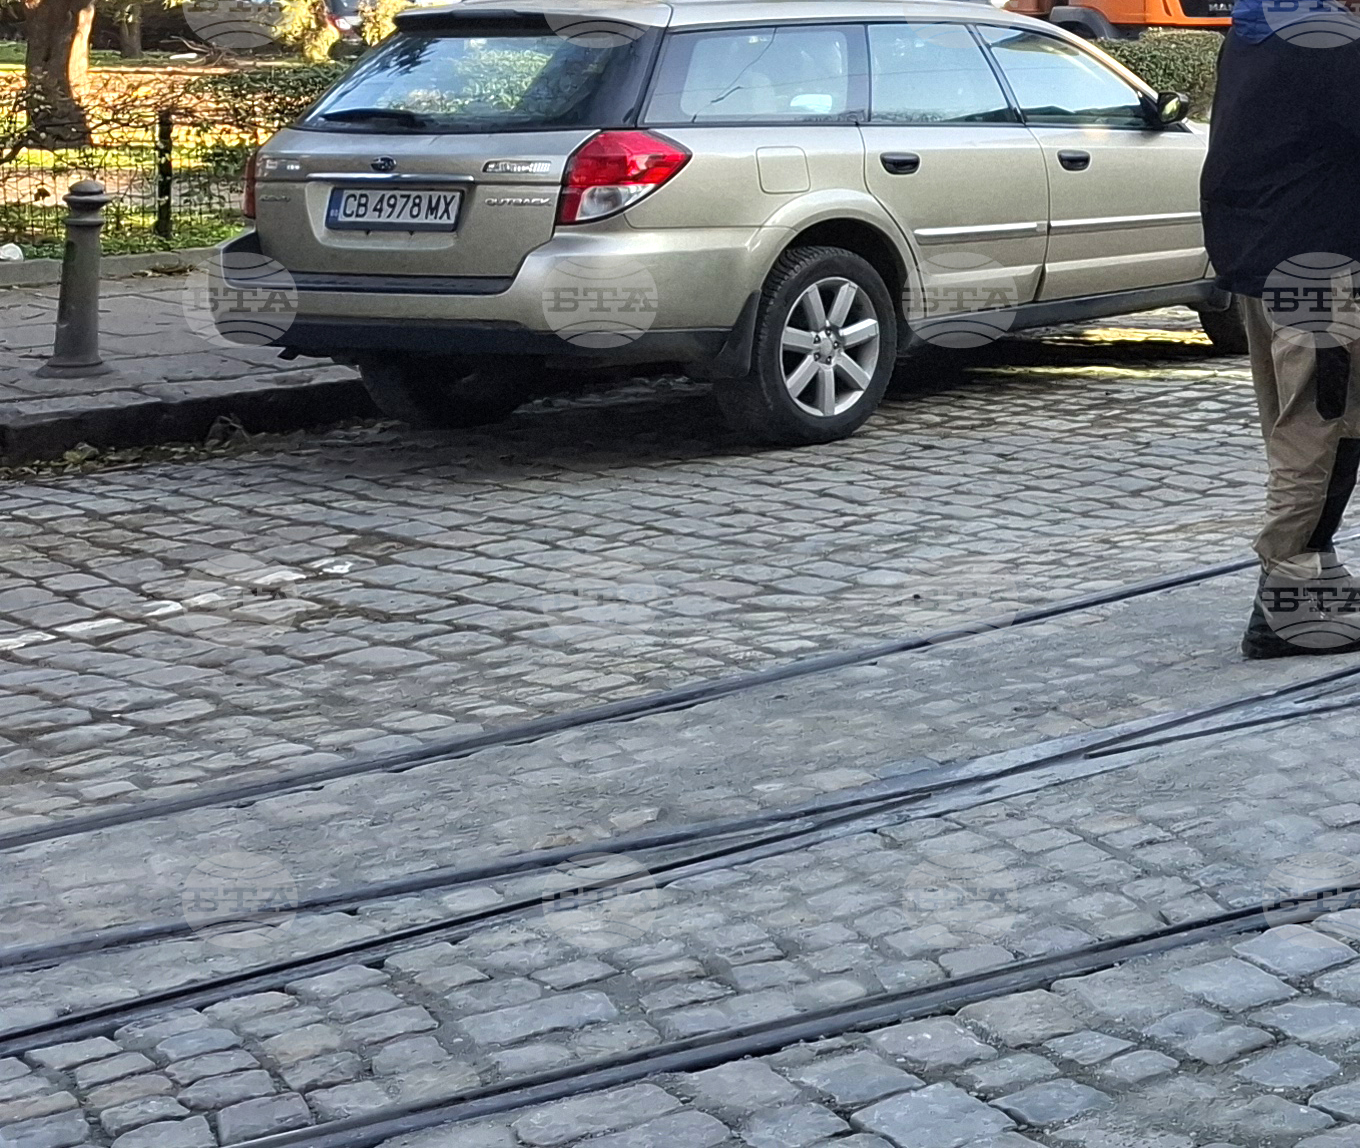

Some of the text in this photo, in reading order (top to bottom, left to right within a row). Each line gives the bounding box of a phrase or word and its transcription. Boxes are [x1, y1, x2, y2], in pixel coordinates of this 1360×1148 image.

[342, 192, 456, 221] CB 4978 MX
